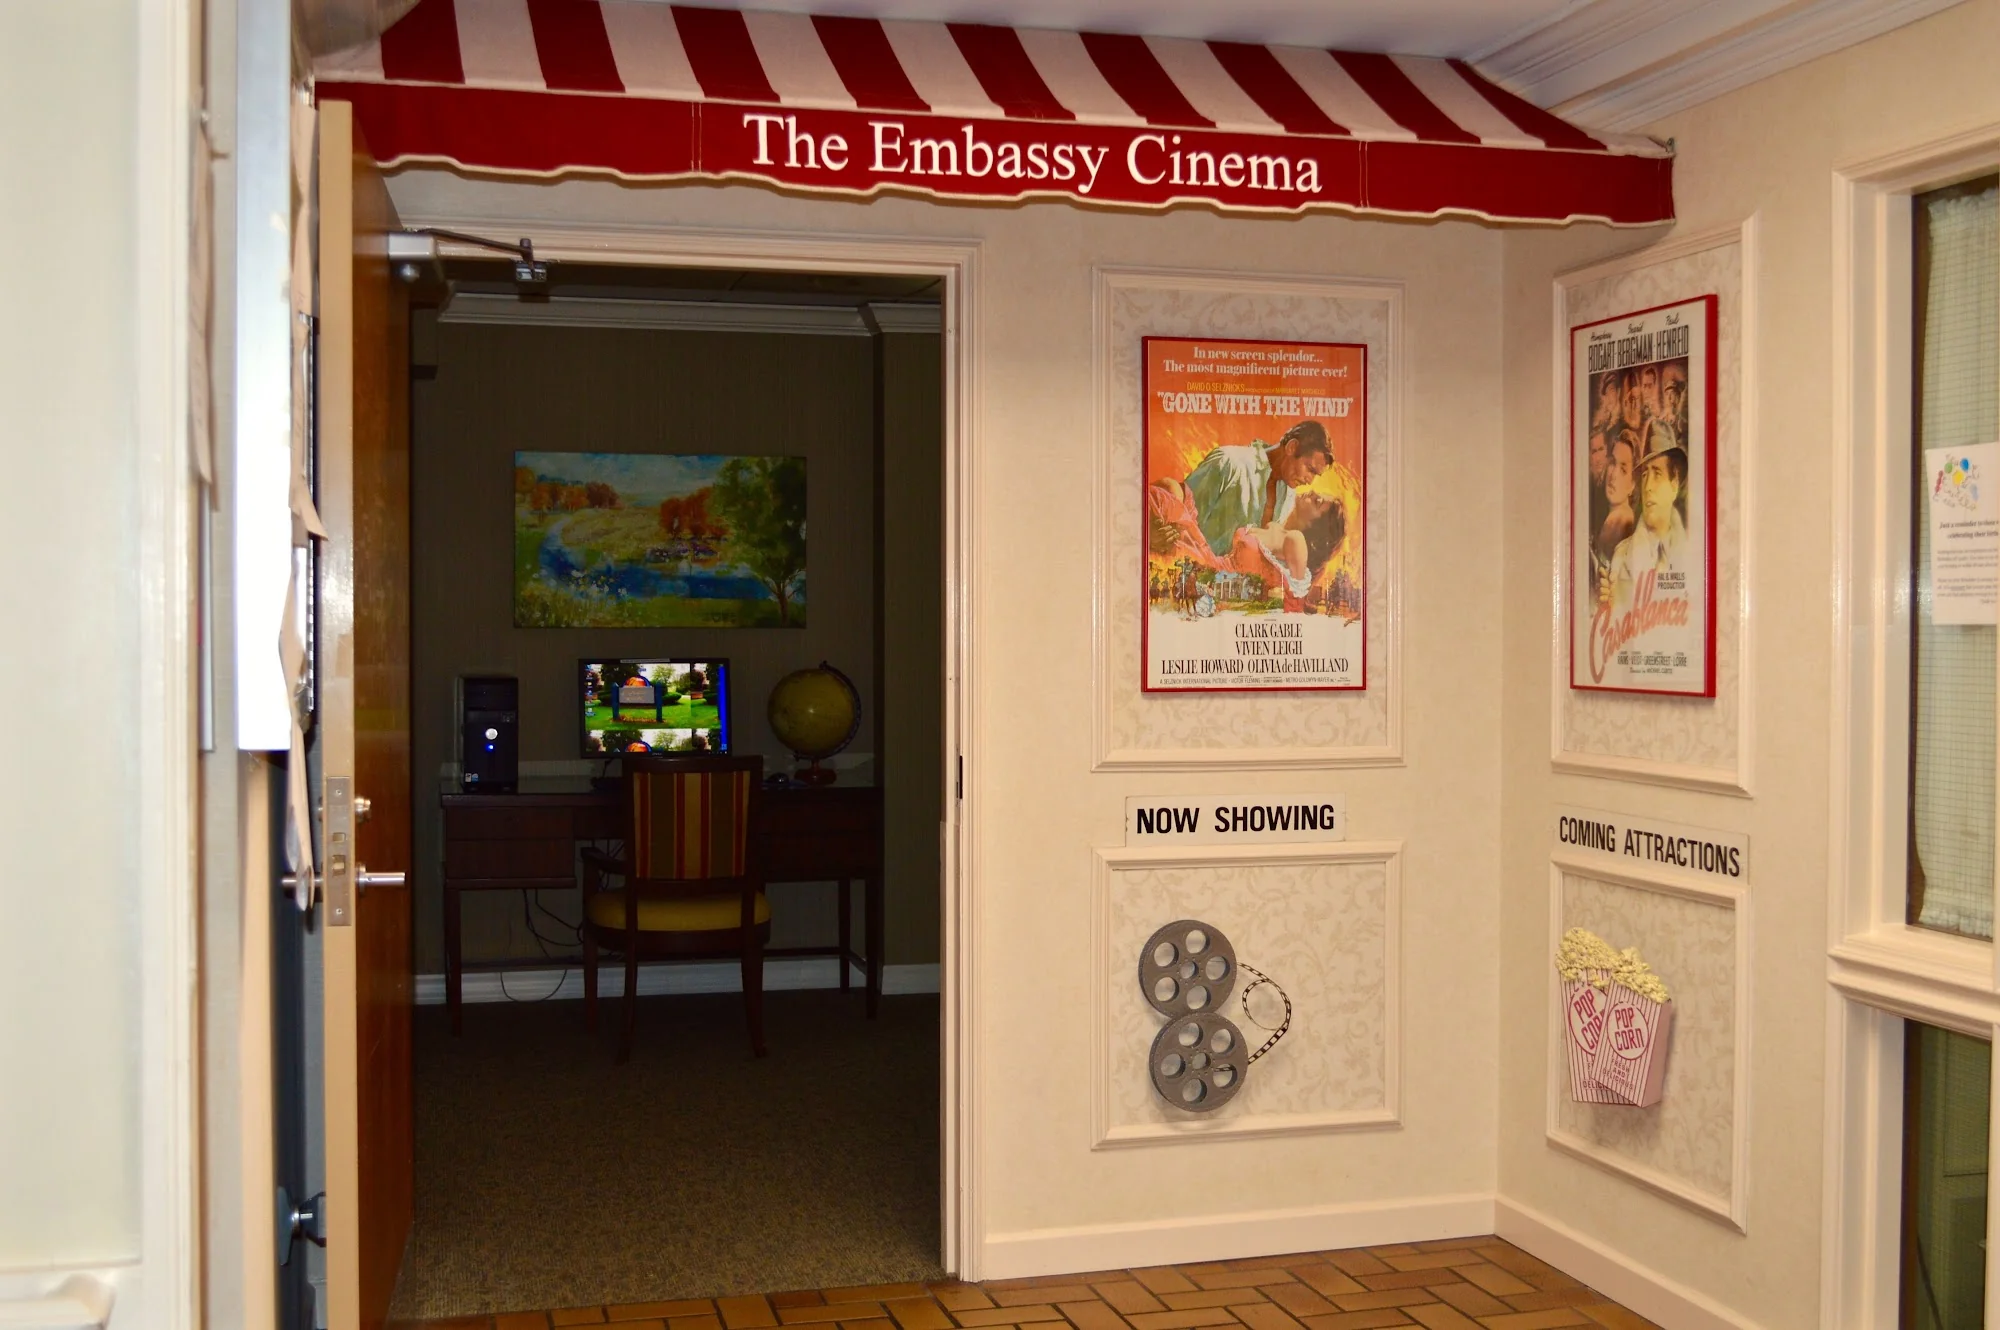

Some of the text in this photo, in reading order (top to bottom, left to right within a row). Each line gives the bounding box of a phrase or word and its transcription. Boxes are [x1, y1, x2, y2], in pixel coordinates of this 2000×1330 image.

[743, 114, 1322, 193] The Embassy Cinema
[1194, 346, 1323, 363] In new screen splendor...
[1589, 325, 1689, 373] BOGART BERGMAN HENREID
[1163, 359, 1348, 378] The most magnificent picture ever!
[1186, 381, 1205, 391] DAVID
[1215, 394, 1261, 415] WITH
[1264, 396, 1301, 416] THE
[1235, 624, 1303, 638] CLARK GABLE
[1589, 568, 1689, 684] Casablanca
[1235, 641, 1303, 655] VIVIEN LEIGH
[1162, 659, 1198, 675] LESLIE
[1200, 659, 1244, 675] HOWARD
[1247, 658, 1282, 674] OLIVIA
[1136, 804, 1334, 834] NOW SHOWING
[1559, 816, 1740, 877] COMING ATTRACTIONS
[1573, 989, 1597, 1024] POP
[1614, 1007, 1635, 1029] POP
[1614, 1027, 1645, 1051] CORN
